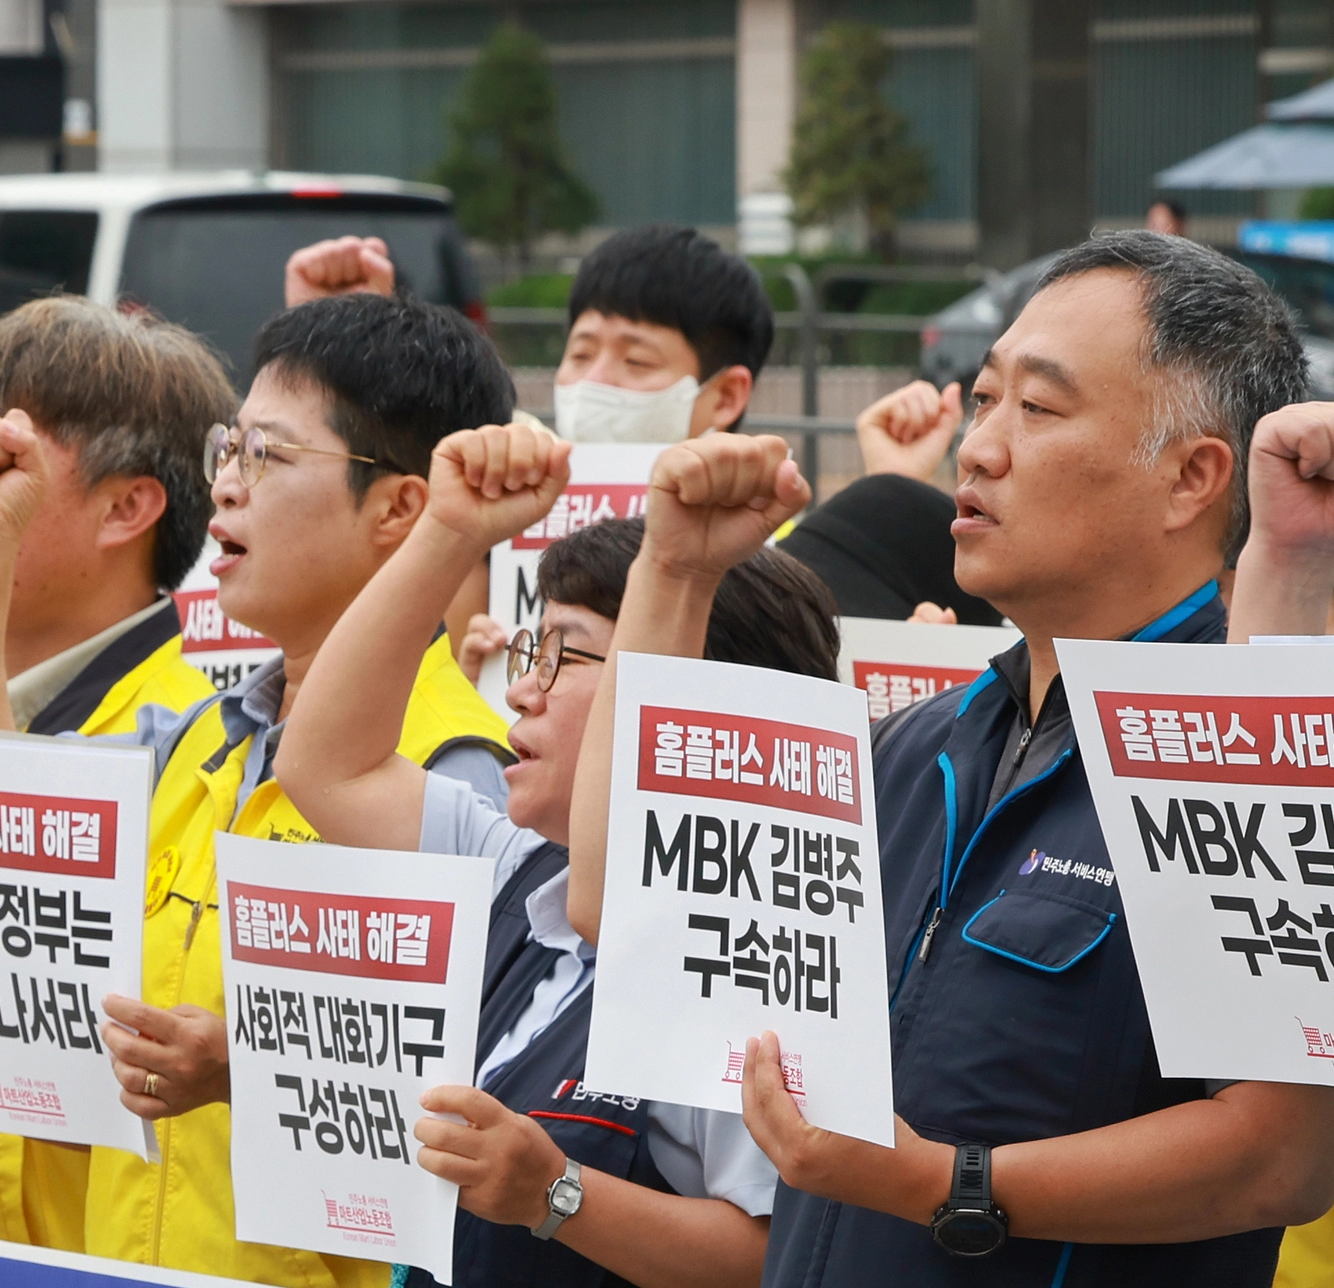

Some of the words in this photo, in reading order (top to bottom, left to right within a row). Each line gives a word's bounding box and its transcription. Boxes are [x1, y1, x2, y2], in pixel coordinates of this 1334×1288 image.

[653, 720, 764, 787] 홈플러스
[769, 738, 811, 796] 사태
[816, 745, 855, 806] 해결
[1115, 705, 1261, 767] 홈플러스
[41, 809, 101, 863] 해결
[641, 809, 763, 901] MBK
[769, 826, 865, 924] 김병주
[1041, 856, 1072, 876] 민주노총
[1070, 862, 1115, 887] 서비스연맹
[1130, 795, 1287, 883] MBK
[235, 893, 312, 954] 홈플러스
[315, 908, 360, 961] 사태
[366, 910, 430, 966] 해결
[683, 913, 841, 1019] 구속하라
[235, 982, 312, 1060] 사회적
[315, 995, 446, 1076] 대화기구
[274, 1073, 411, 1165] 구성하라
